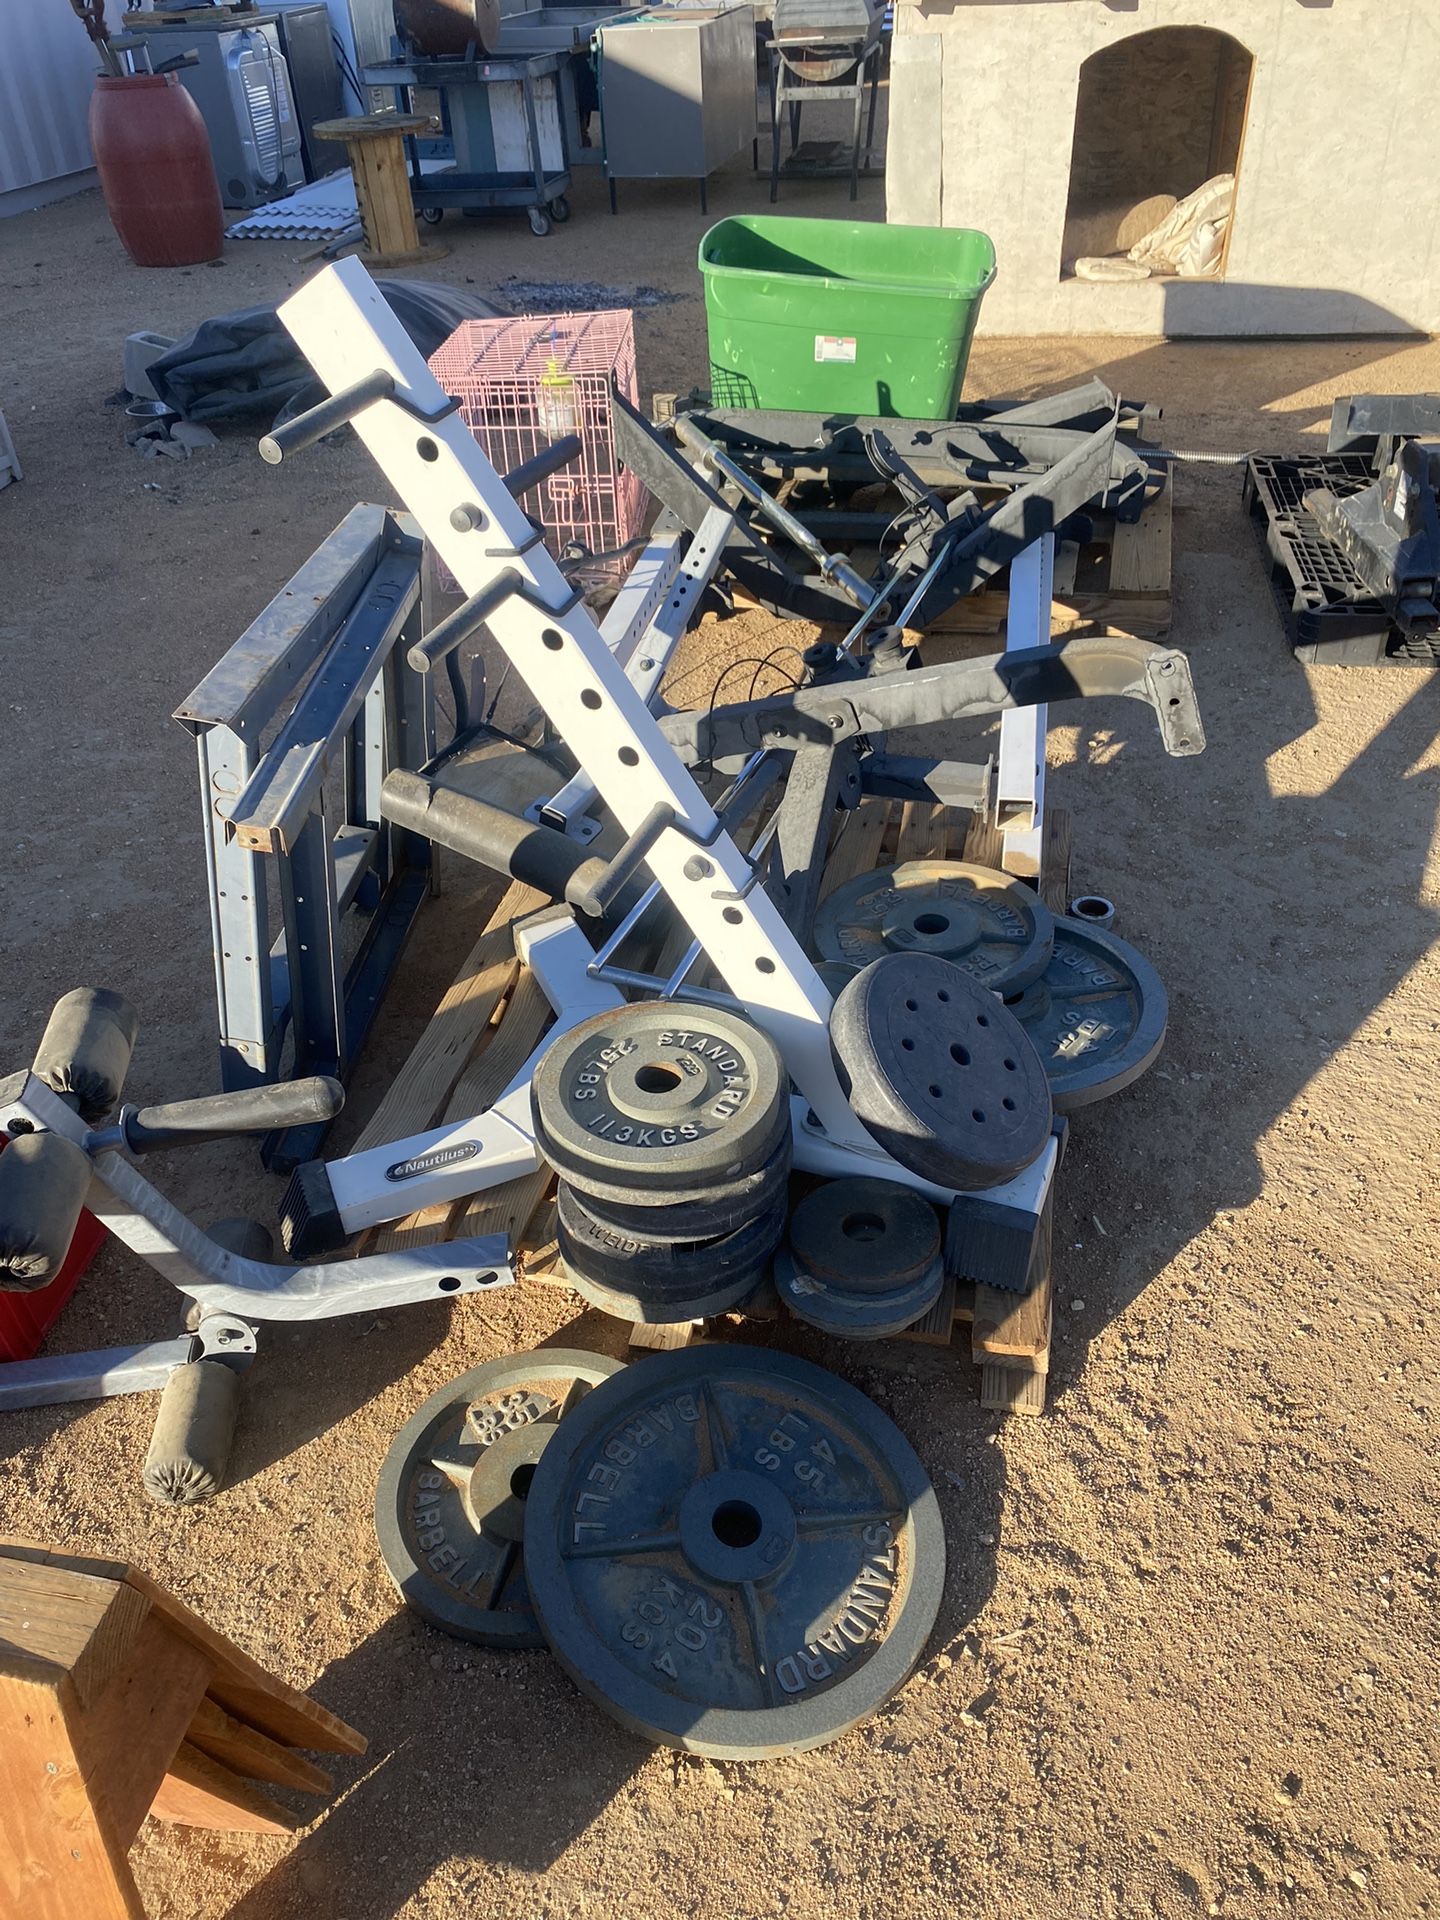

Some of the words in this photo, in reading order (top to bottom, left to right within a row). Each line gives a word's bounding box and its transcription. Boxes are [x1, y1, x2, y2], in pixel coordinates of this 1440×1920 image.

[1062, 1011, 1119, 1042] LBS
[657, 1031, 746, 1121] STANDARD
[404, 1148, 465, 1174] Nautilus
[572, 1393, 701, 1544] BARBELL
[753, 1412, 808, 1472] LBS
[793, 1437, 837, 1490] 45
[413, 1472, 486, 1600] BARBELL
[620, 1576, 685, 1650] KGS
[650, 1598, 724, 1681] 20.4
[774, 1523, 896, 1694] STANDARD
